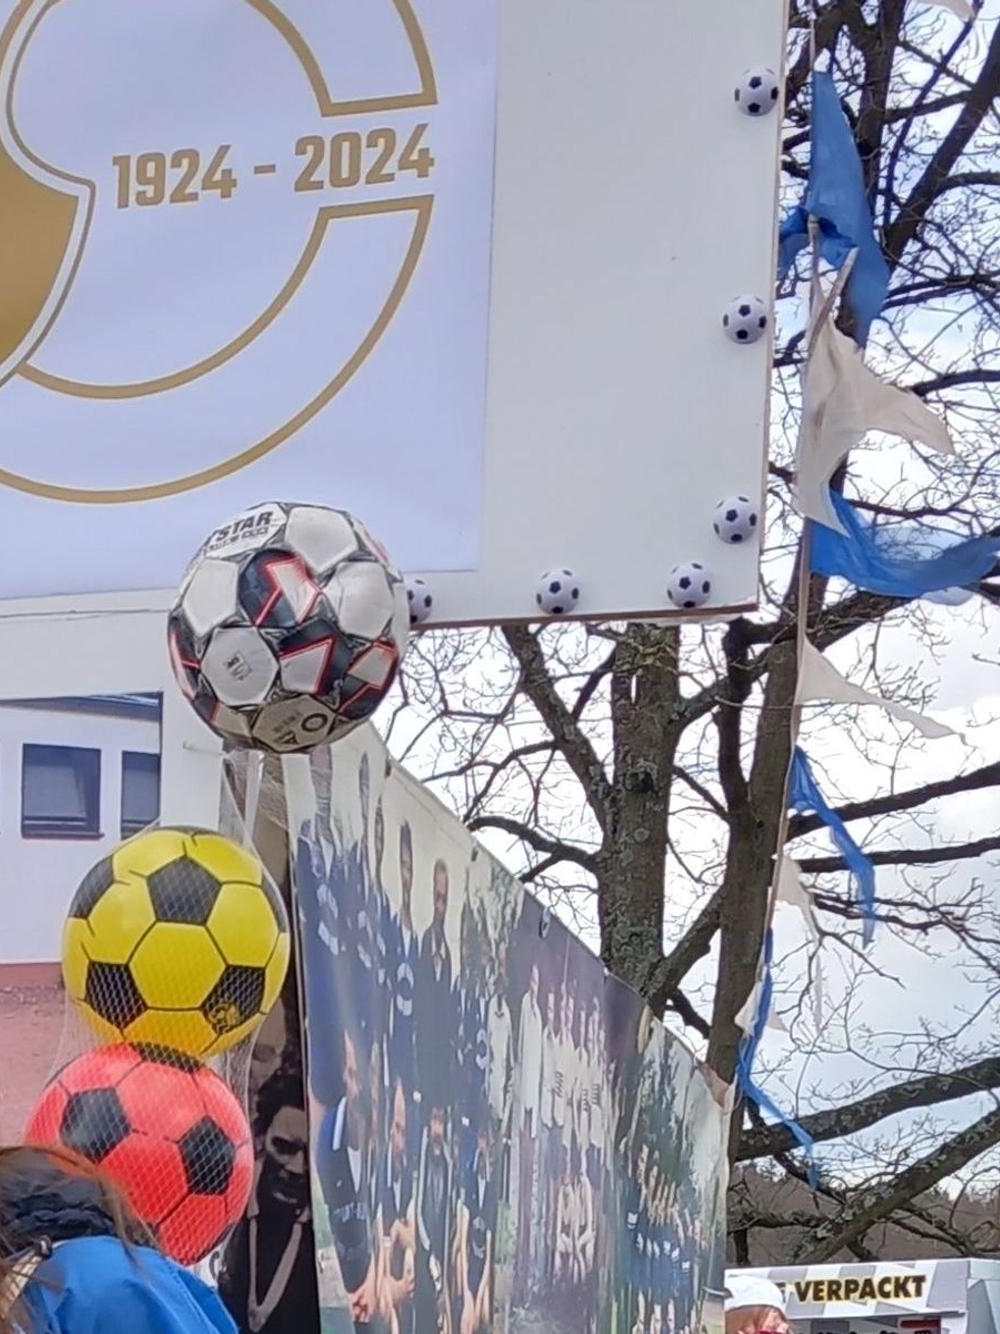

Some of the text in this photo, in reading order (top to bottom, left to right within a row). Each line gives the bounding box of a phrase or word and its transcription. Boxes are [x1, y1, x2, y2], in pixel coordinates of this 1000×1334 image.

[112, 144, 238, 210] 1924
[293, 122, 435, 193] 2024
[794, 1274, 926, 1302] VERPACKT
